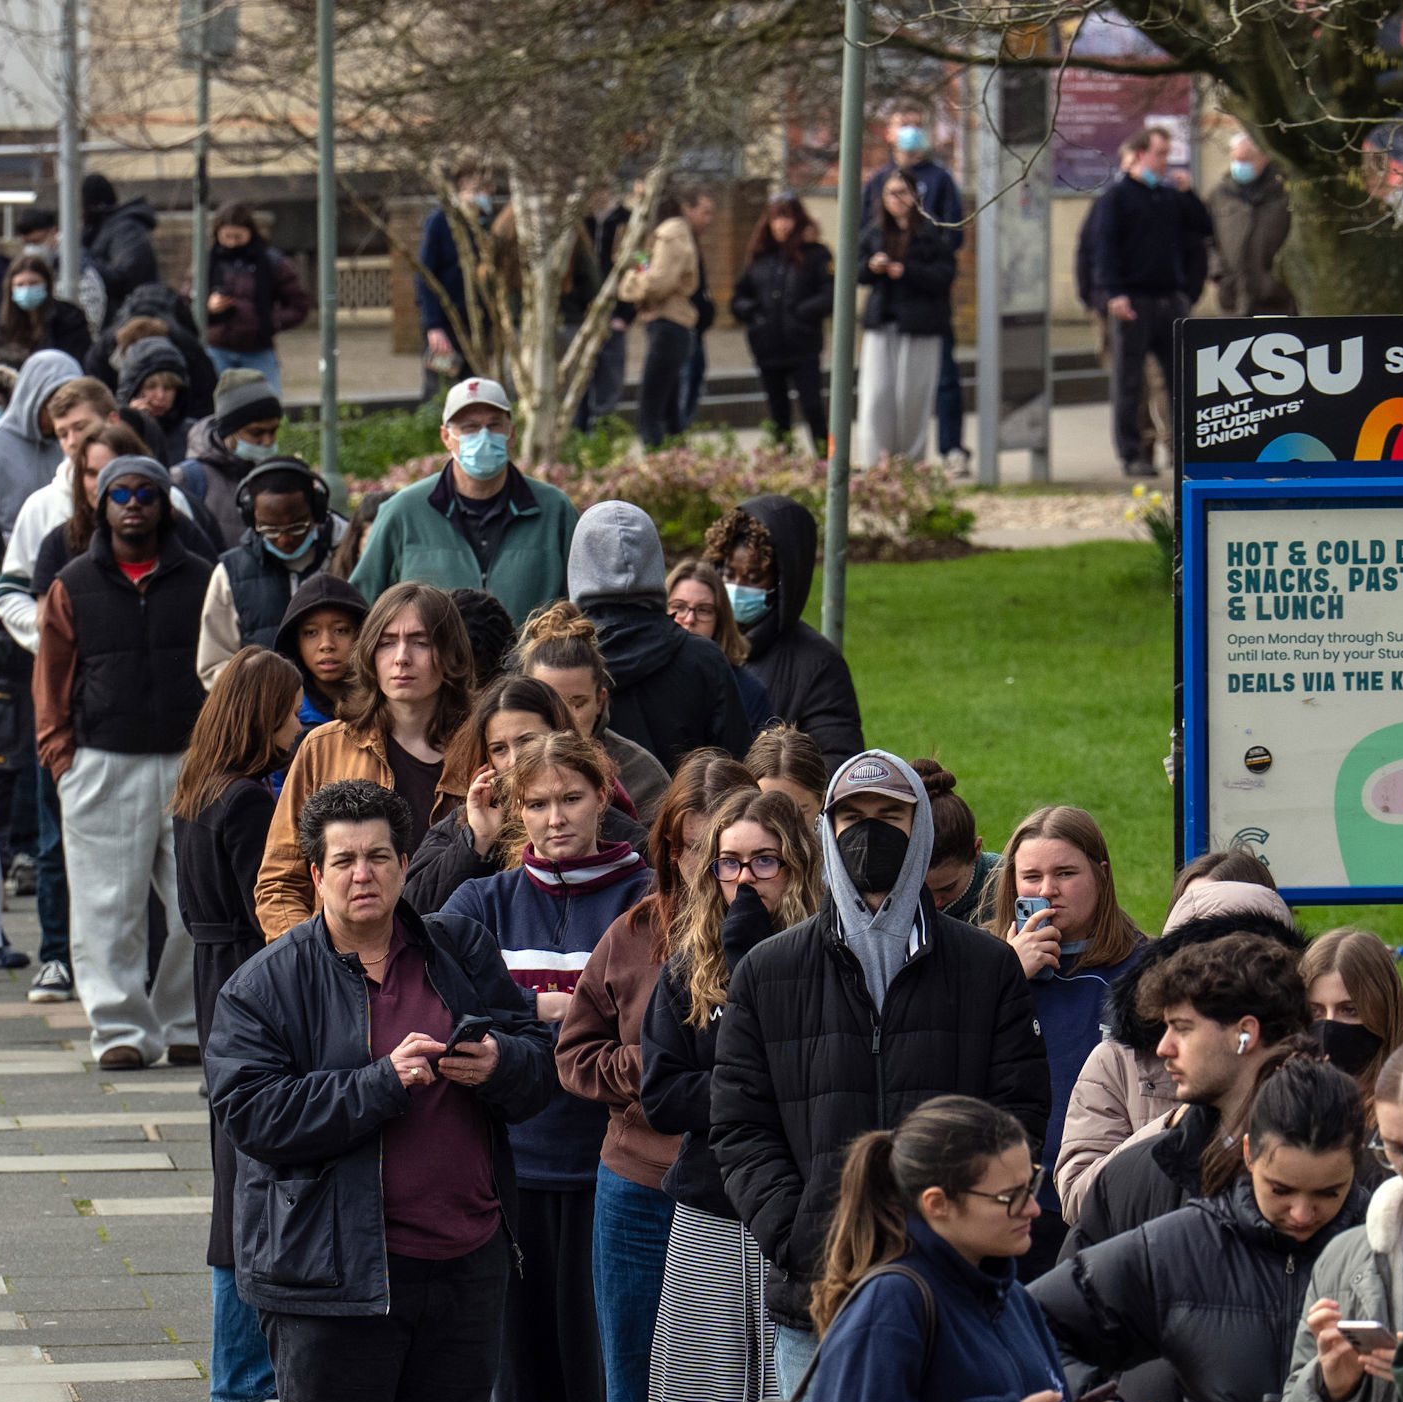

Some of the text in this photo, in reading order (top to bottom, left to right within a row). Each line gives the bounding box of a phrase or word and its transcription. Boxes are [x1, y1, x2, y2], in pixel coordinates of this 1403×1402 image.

[1197, 332, 1363, 397] KSU
[1196, 399, 1305, 436] STUDENTS'
[1197, 397, 1254, 423] KENT
[1197, 423, 1259, 449] UNION
[1227, 541, 1279, 567] HOT
[1288, 540, 1307, 566] &
[1316, 539, 1386, 565] COLD
[1227, 567, 1339, 595] SNACKS,
[1227, 594, 1344, 621] & LUNCH
[1227, 633, 1265, 648] Open
[1268, 632, 1324, 648] Monday
[1327, 631, 1384, 647] through
[1227, 649, 1258, 662] until
[1260, 649, 1291, 662] late.
[1294, 649, 1320, 661] Run
[1322, 647, 1342, 663] by
[1344, 650, 1375, 663] your
[1227, 672, 1296, 694] DEALS
[1302, 671, 1336, 693] VIA
[1342, 670, 1384, 692] THE
